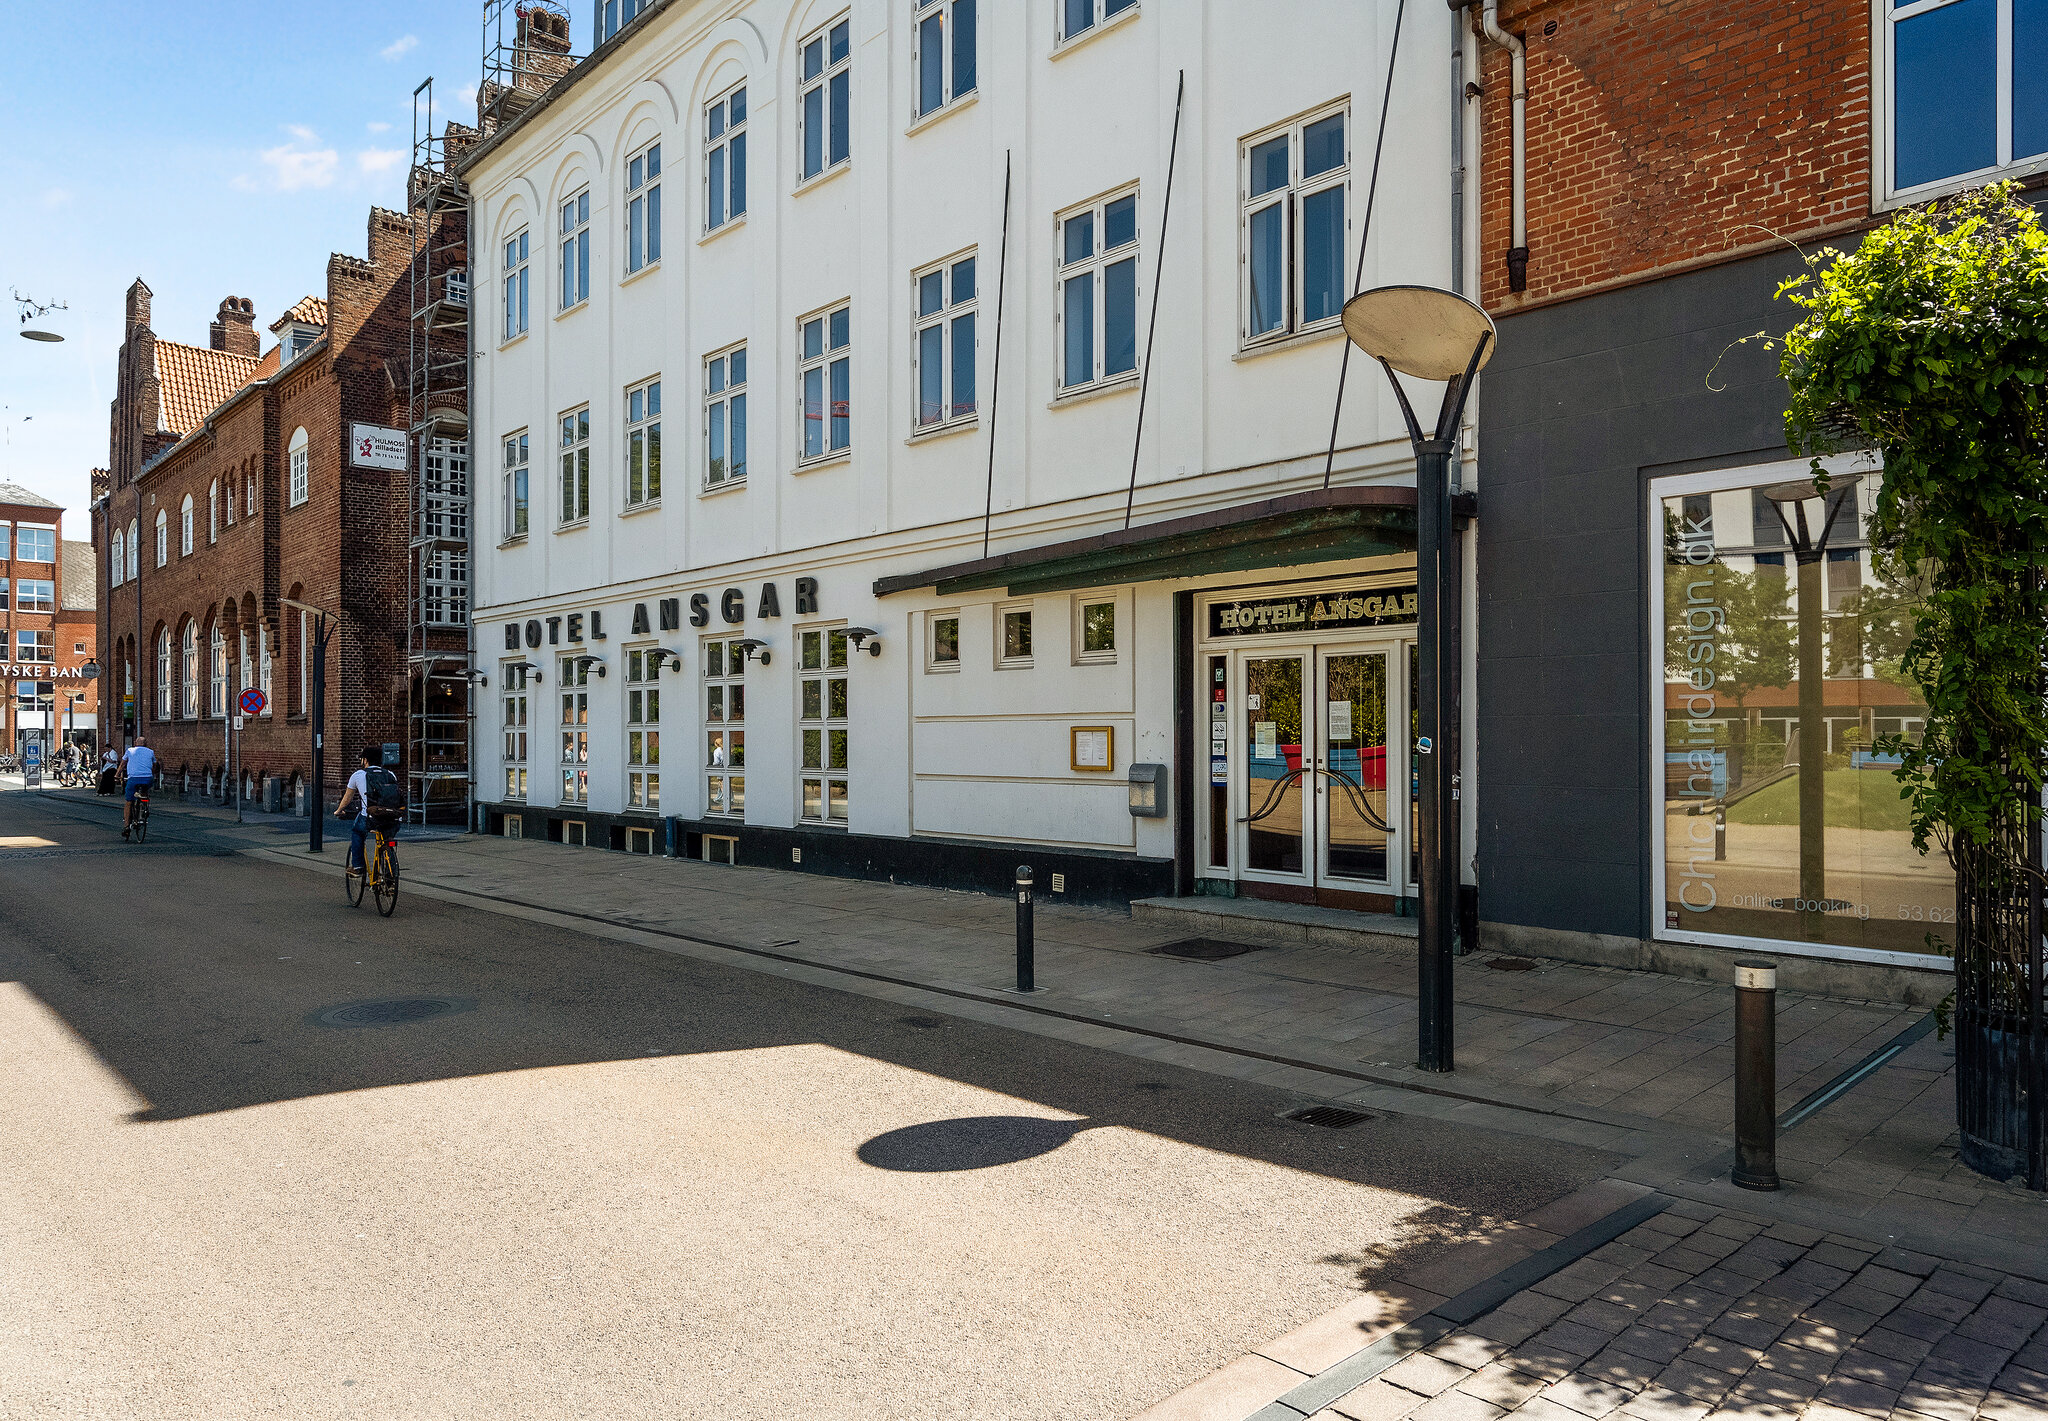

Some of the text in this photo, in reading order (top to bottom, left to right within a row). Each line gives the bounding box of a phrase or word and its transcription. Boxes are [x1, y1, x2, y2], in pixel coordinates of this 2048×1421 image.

[375, 438, 406, 448] HULMOSE
[505, 576, 819, 650] HOTEL ANSGAR
[1220, 593, 1418, 629] HOTEL ANSGAR
[1733, 892, 1956, 924] online booking 53 62
